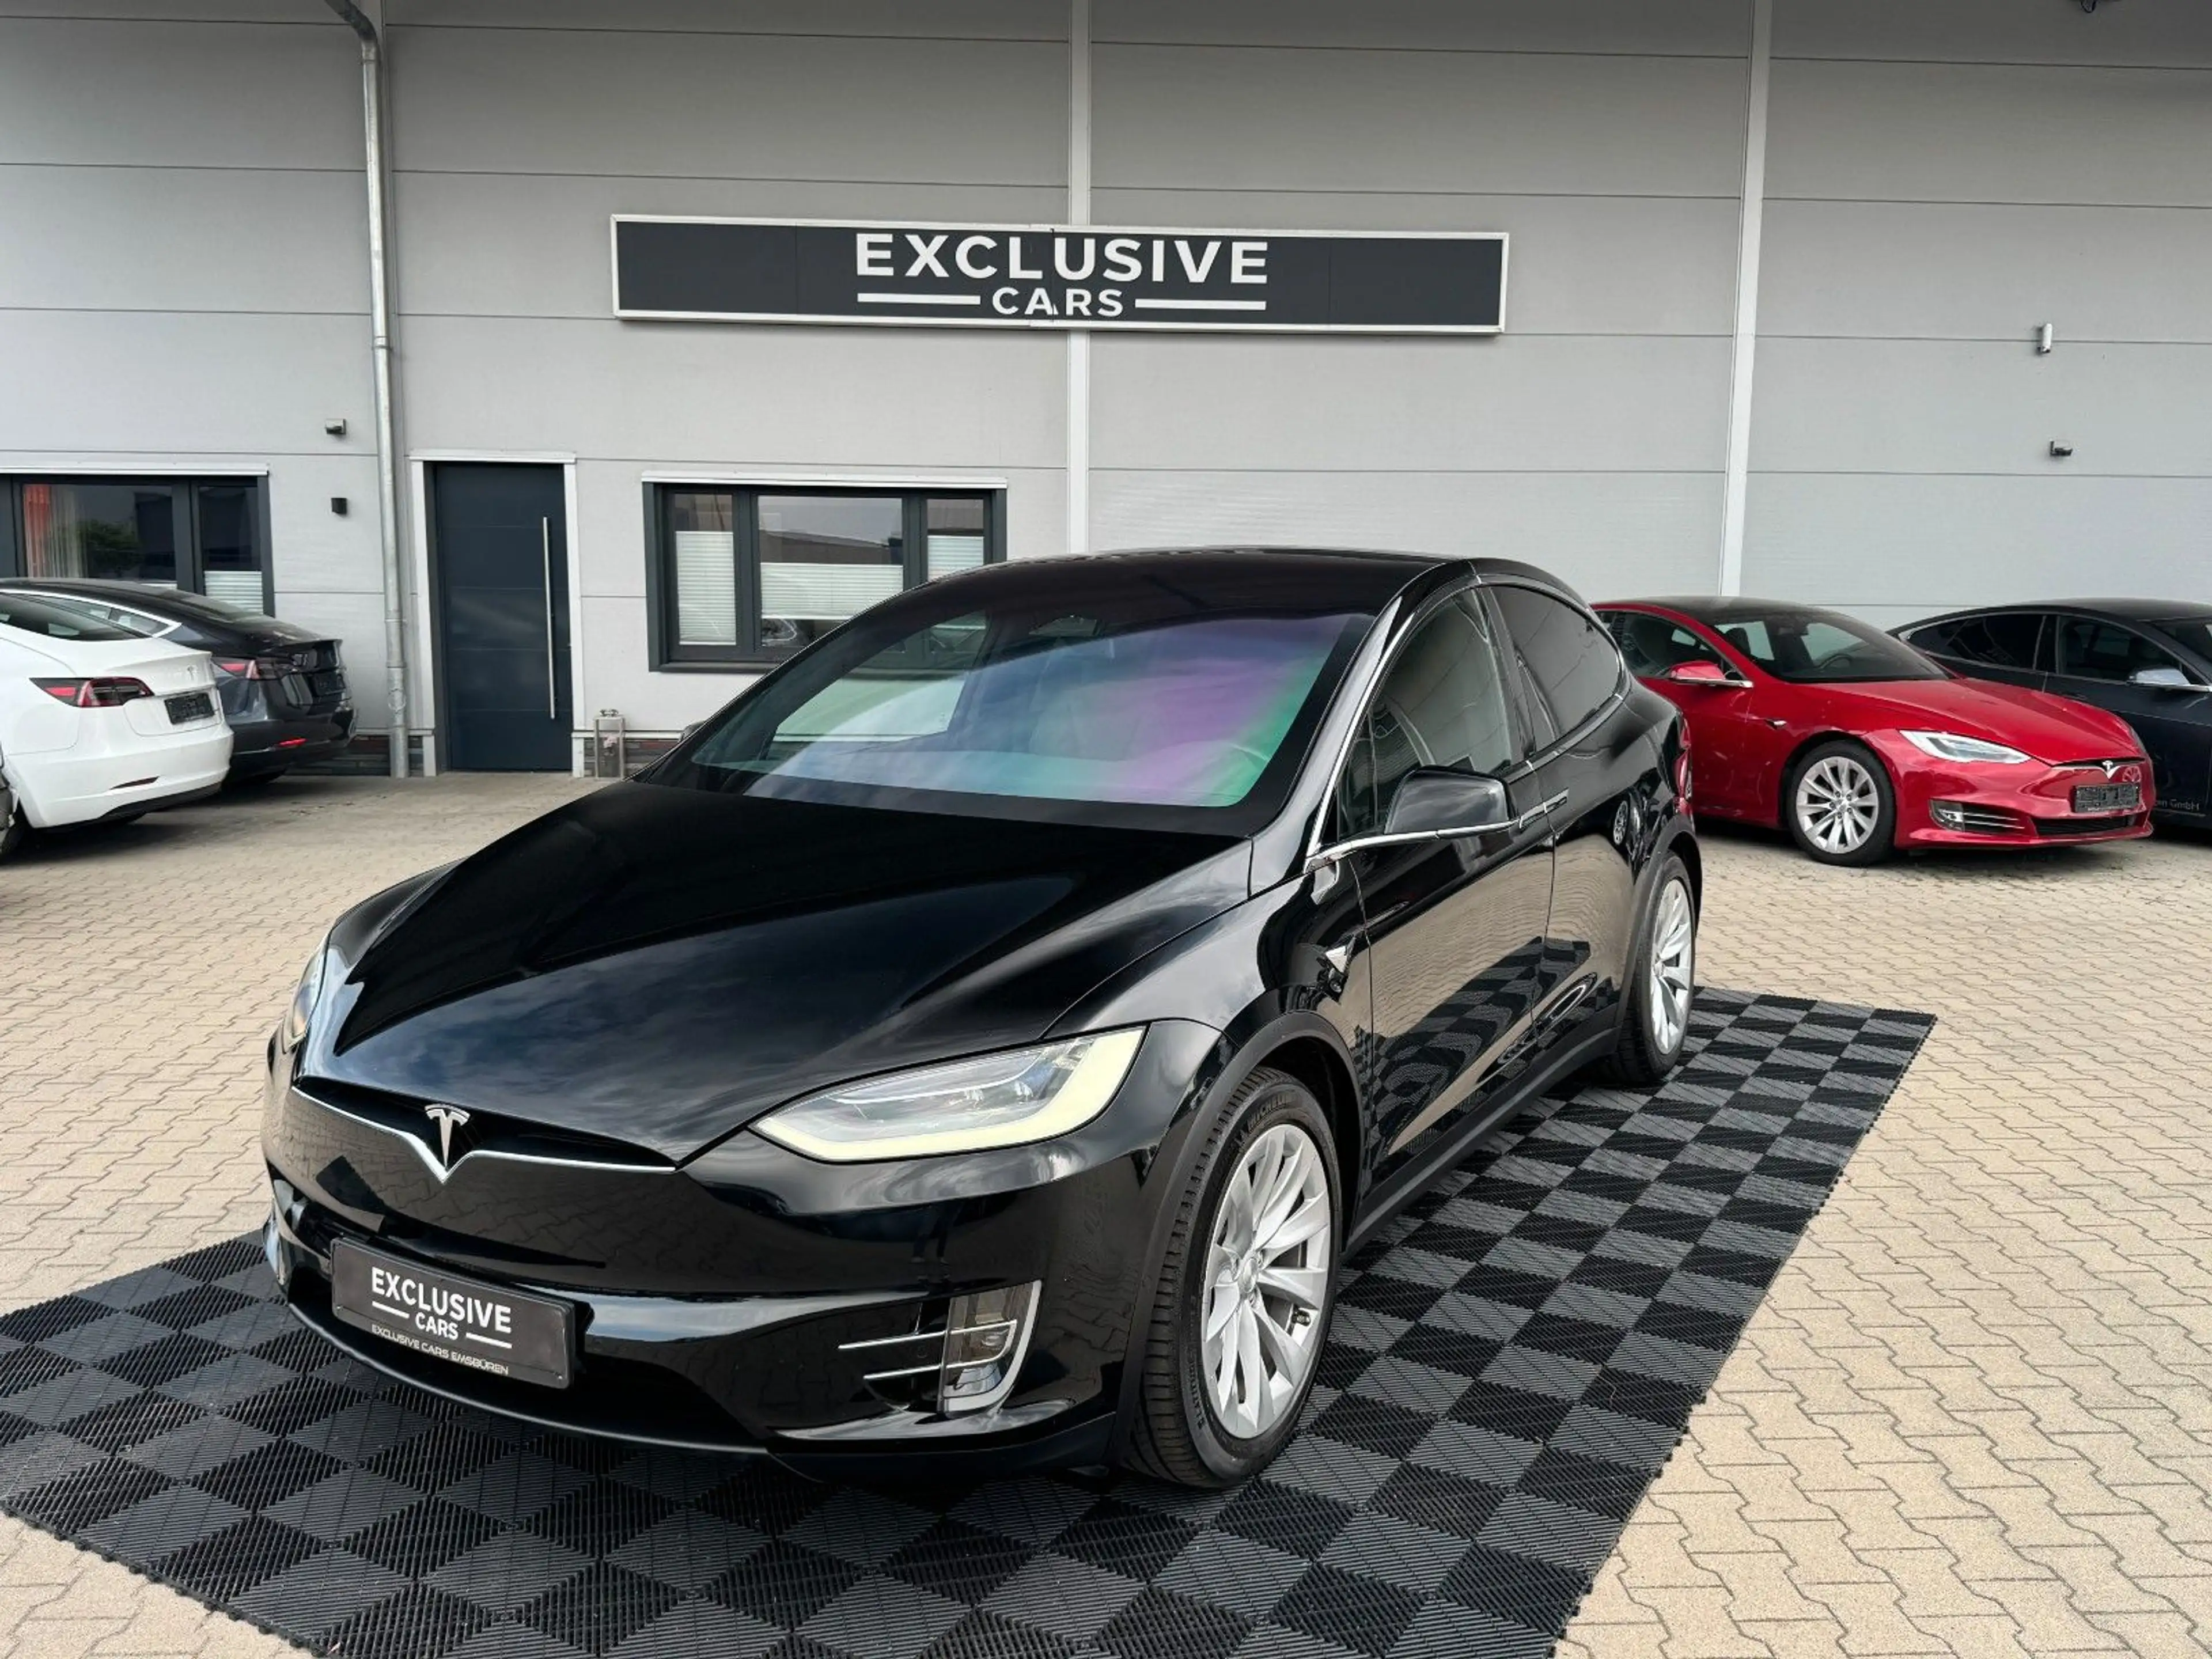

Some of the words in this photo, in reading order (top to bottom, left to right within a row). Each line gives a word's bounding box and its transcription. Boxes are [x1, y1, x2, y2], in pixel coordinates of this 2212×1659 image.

[856, 233, 1268, 285] EXCLUSIVE
[992, 287, 1124, 317] CARS
[372, 1266, 512, 1334] EXCLUSIVE
[371, 1324, 420, 1350] EXCLUSIVE
[421, 1342, 449, 1359] CARS
[450, 1351, 509, 1376] EMSBÜREN
[415, 1312, 459, 1341] CARS
